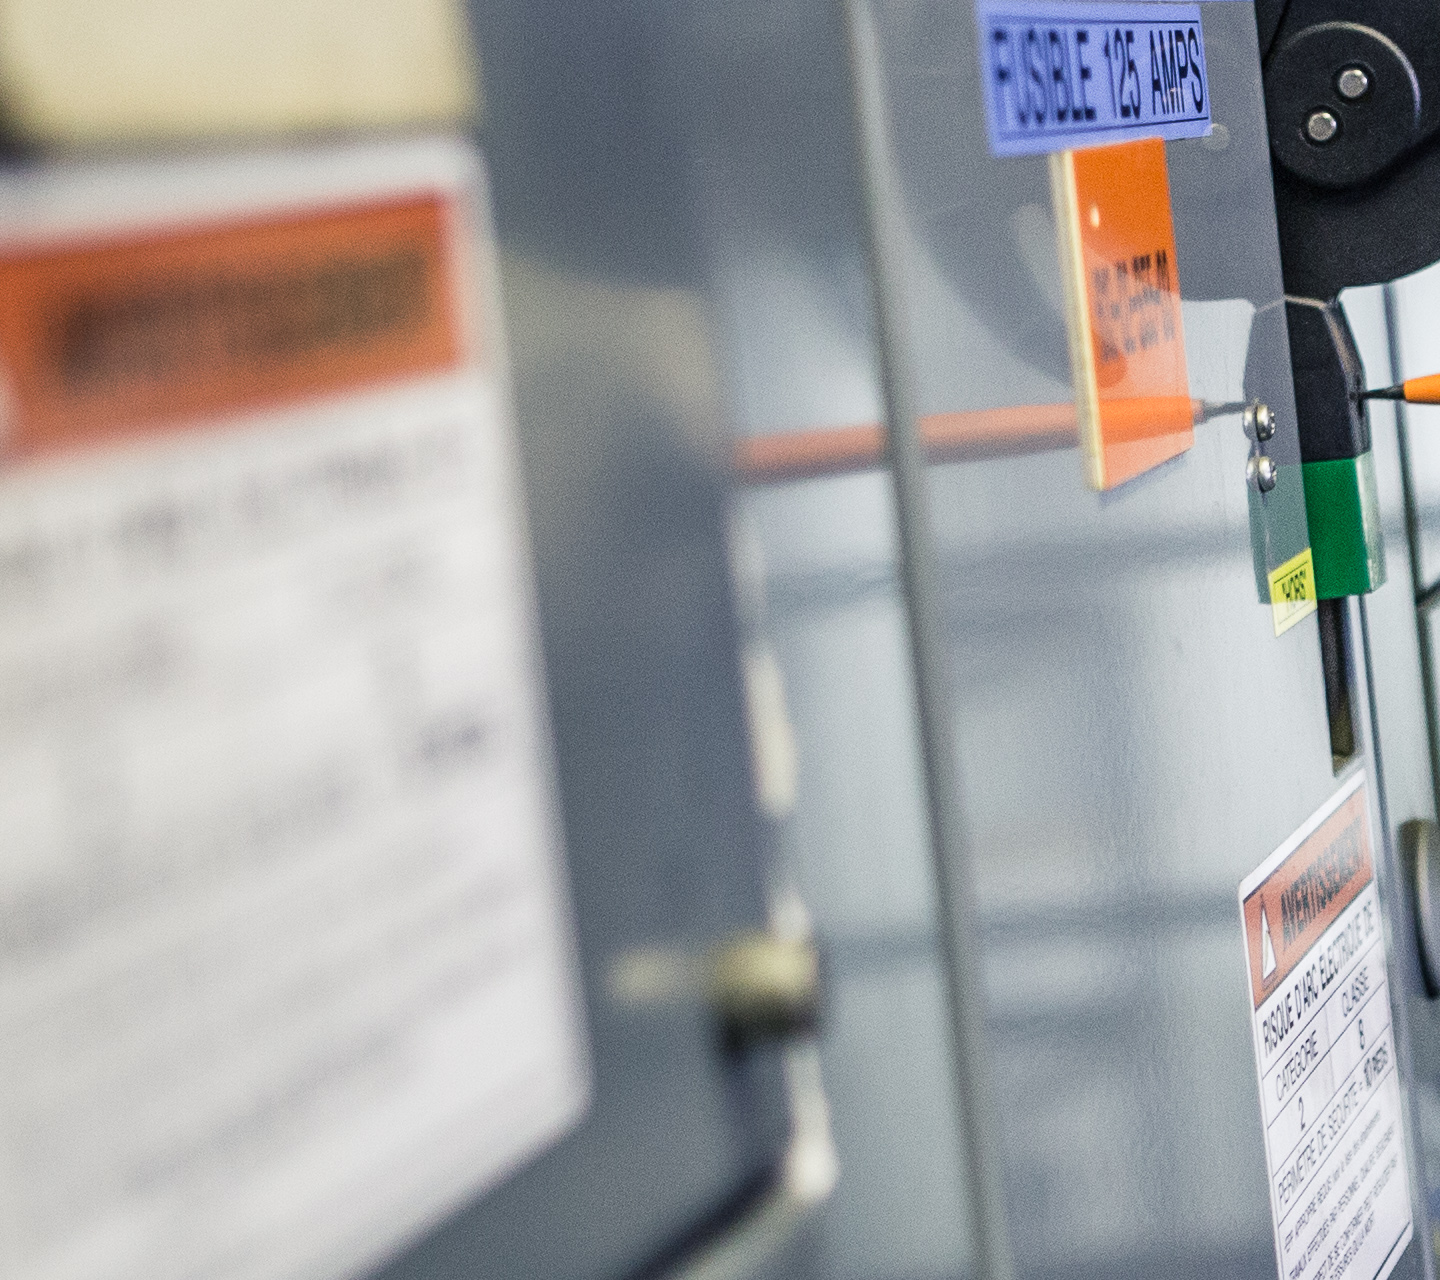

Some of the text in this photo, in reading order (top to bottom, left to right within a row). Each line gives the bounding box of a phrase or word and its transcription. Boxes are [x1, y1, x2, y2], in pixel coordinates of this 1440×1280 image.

[990, 27, 1204, 124] FUSIBLE 125 AMPS
[1262, 993, 1293, 1056] RISQUE
[1295, 965, 1318, 1017] D'ARC
[1341, 966, 1368, 1017] CLASSE
[1298, 1096, 1305, 1132] 2
